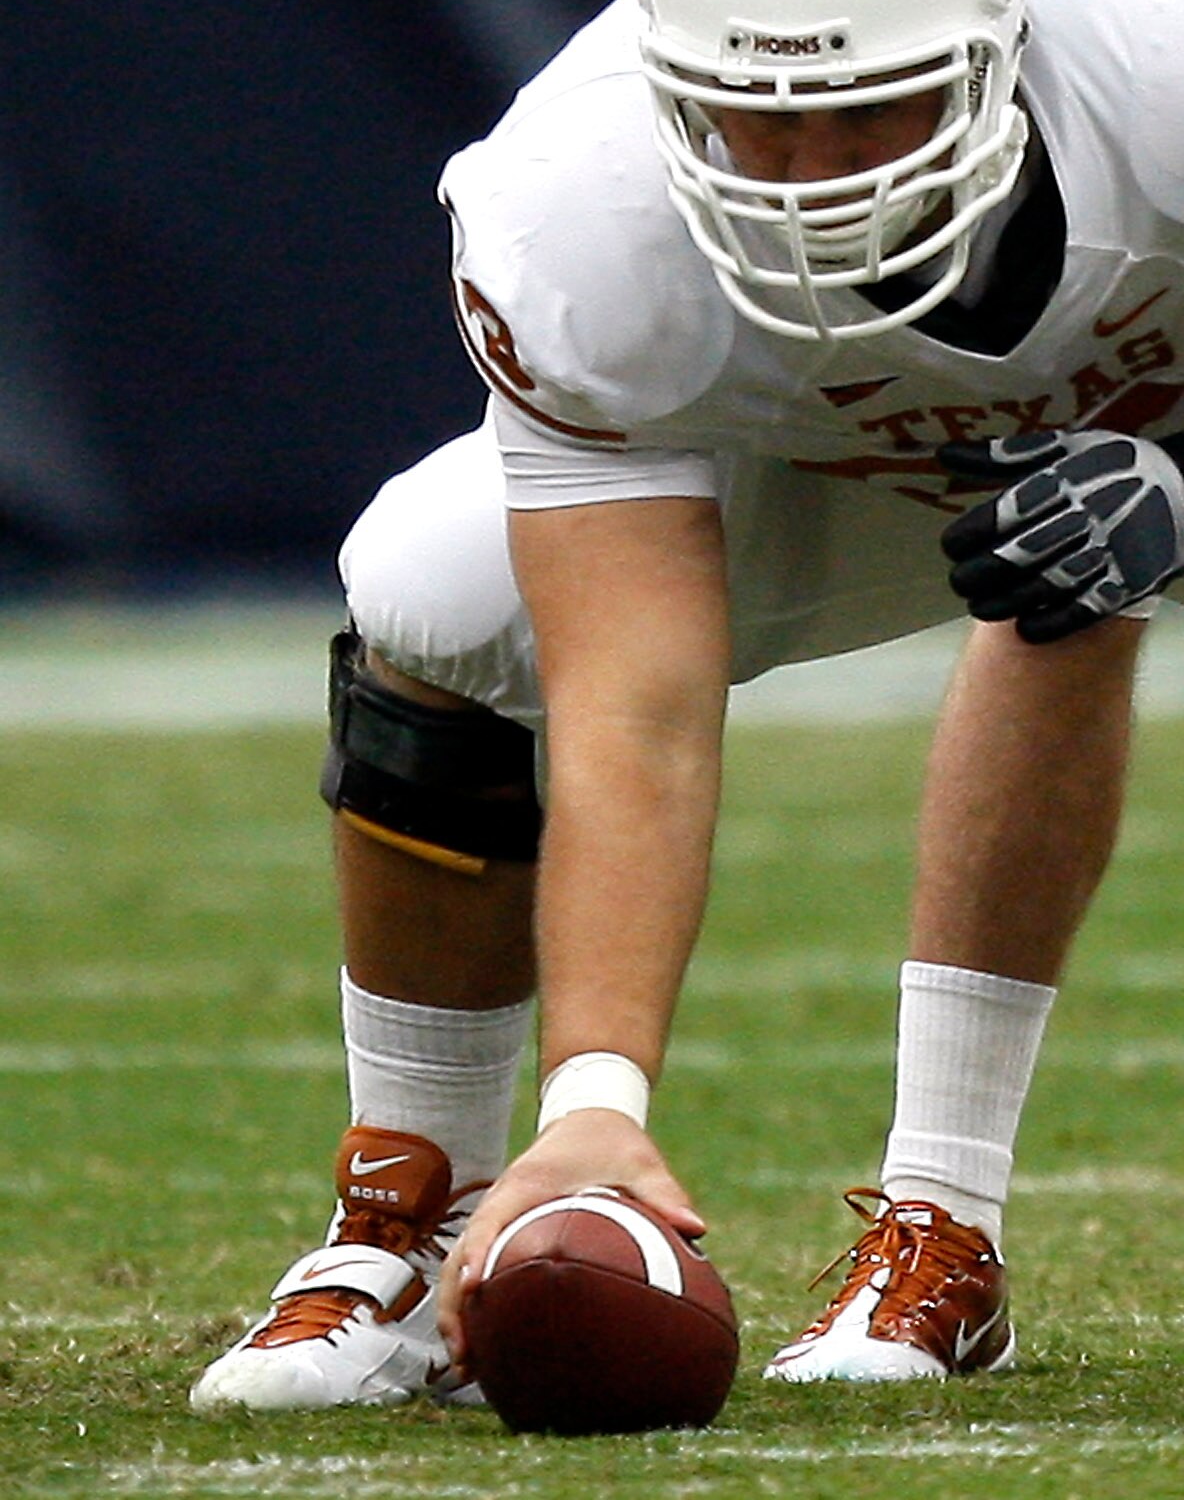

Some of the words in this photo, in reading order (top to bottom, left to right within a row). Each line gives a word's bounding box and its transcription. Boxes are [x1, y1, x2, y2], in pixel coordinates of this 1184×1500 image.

[754, 36, 821, 56] HORNS
[858, 329, 1175, 451] TEXAS
[349, 1185, 400, 1203] BOSS
